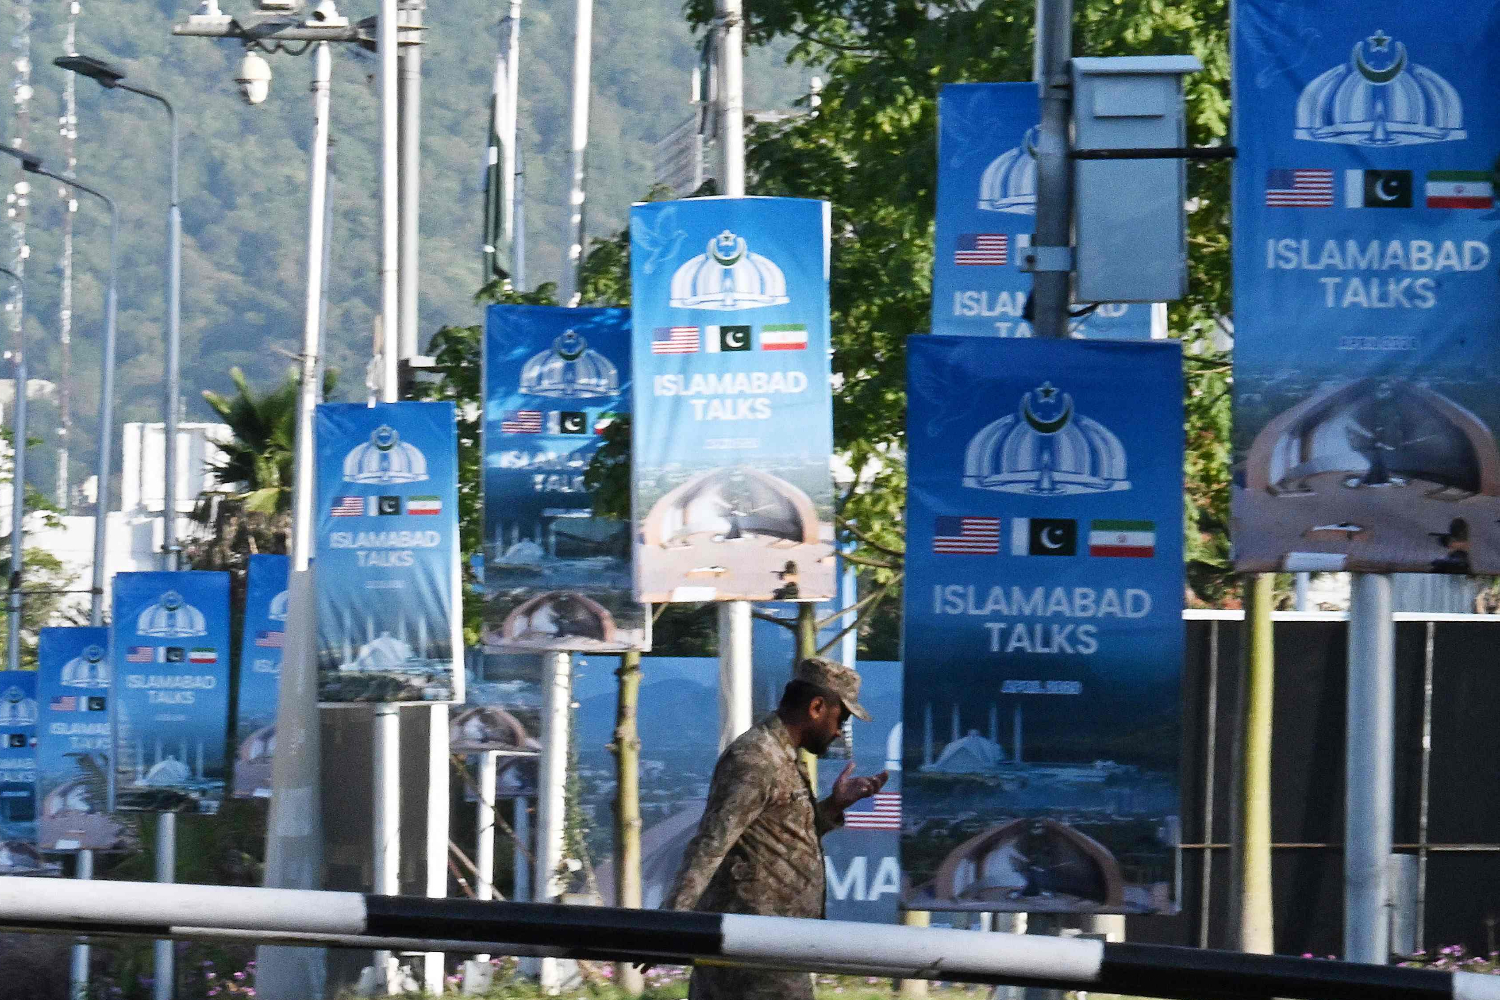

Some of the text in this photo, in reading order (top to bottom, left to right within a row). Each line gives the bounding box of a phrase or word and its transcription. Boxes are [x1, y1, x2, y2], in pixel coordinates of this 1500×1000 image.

[1266, 239, 1491, 271] ISLAMABAD
[1319, 277, 1437, 309] TALKS
[654, 372, 808, 396] ISLAMABAD
[690, 399, 772, 421] TALKS
[330, 531, 441, 548] ISLAMABAD
[356, 550, 414, 567] TALKS
[933, 584, 1152, 618] ISLAMABAD
[984, 622, 1099, 654] TALKS
